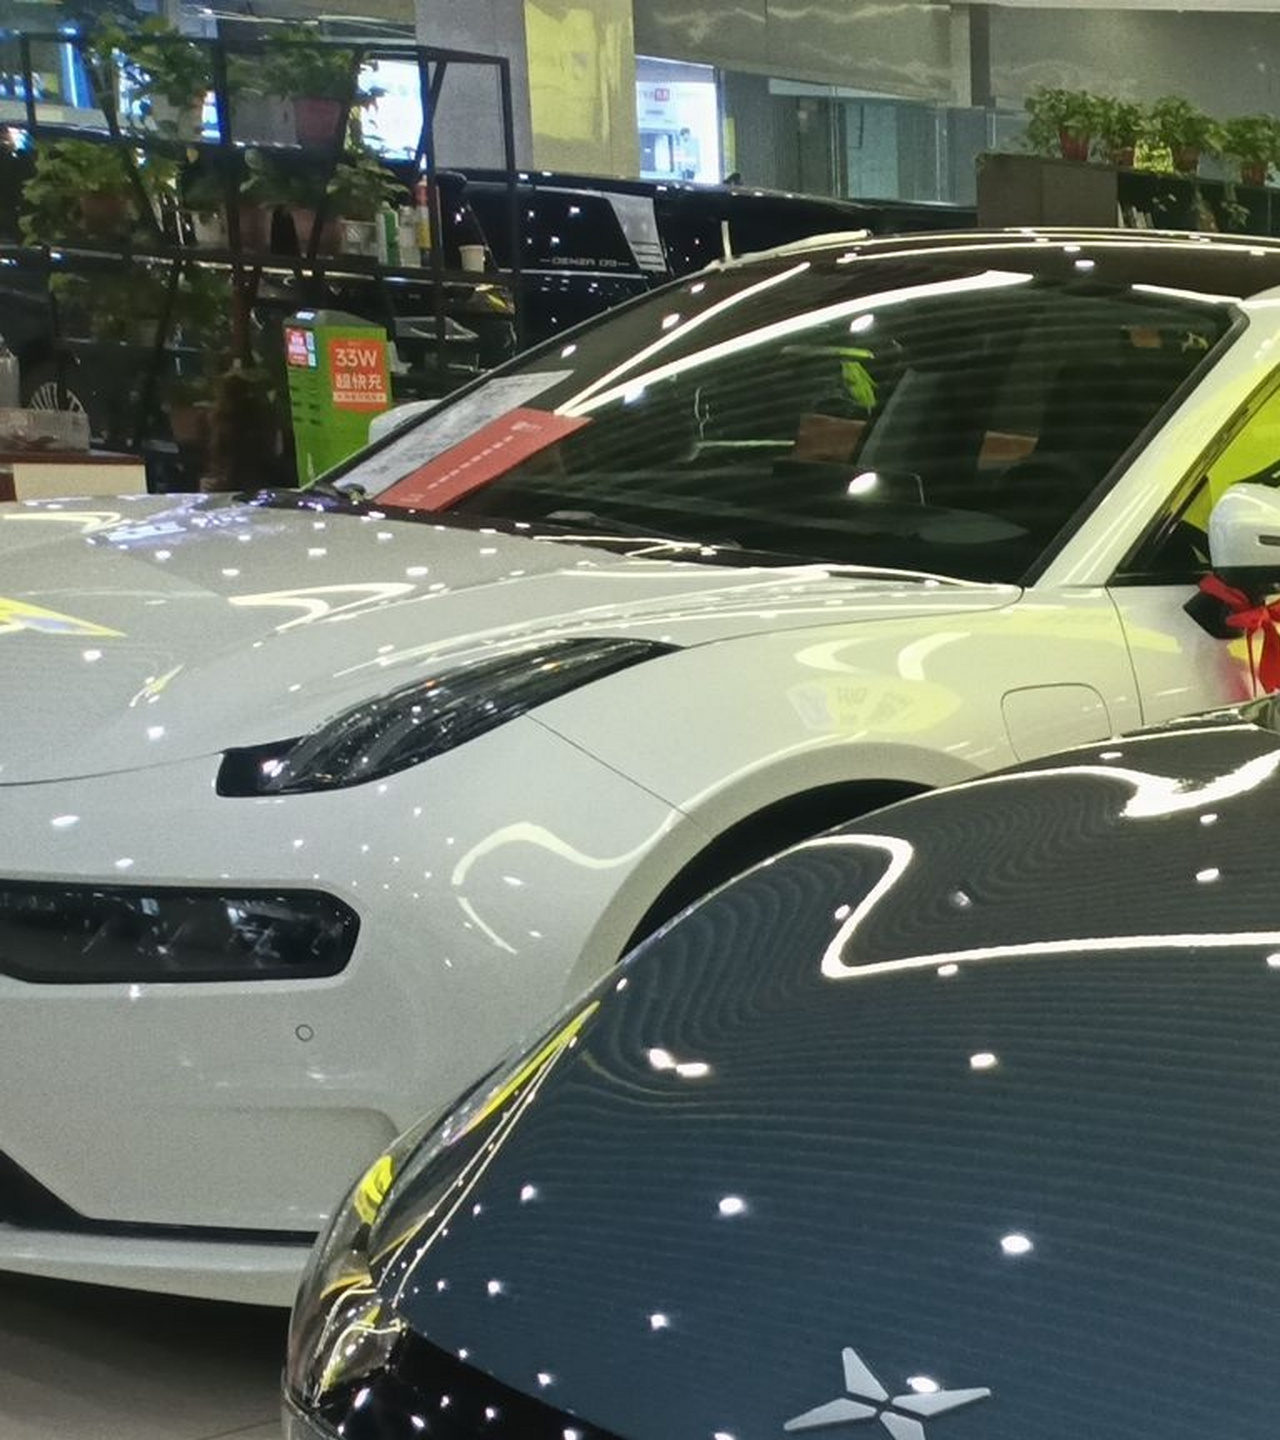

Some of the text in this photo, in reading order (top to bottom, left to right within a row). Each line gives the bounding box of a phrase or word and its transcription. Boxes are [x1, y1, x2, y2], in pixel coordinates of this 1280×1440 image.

[334, 347, 378, 367] 33W
[334, 372, 383, 390] 超快充
